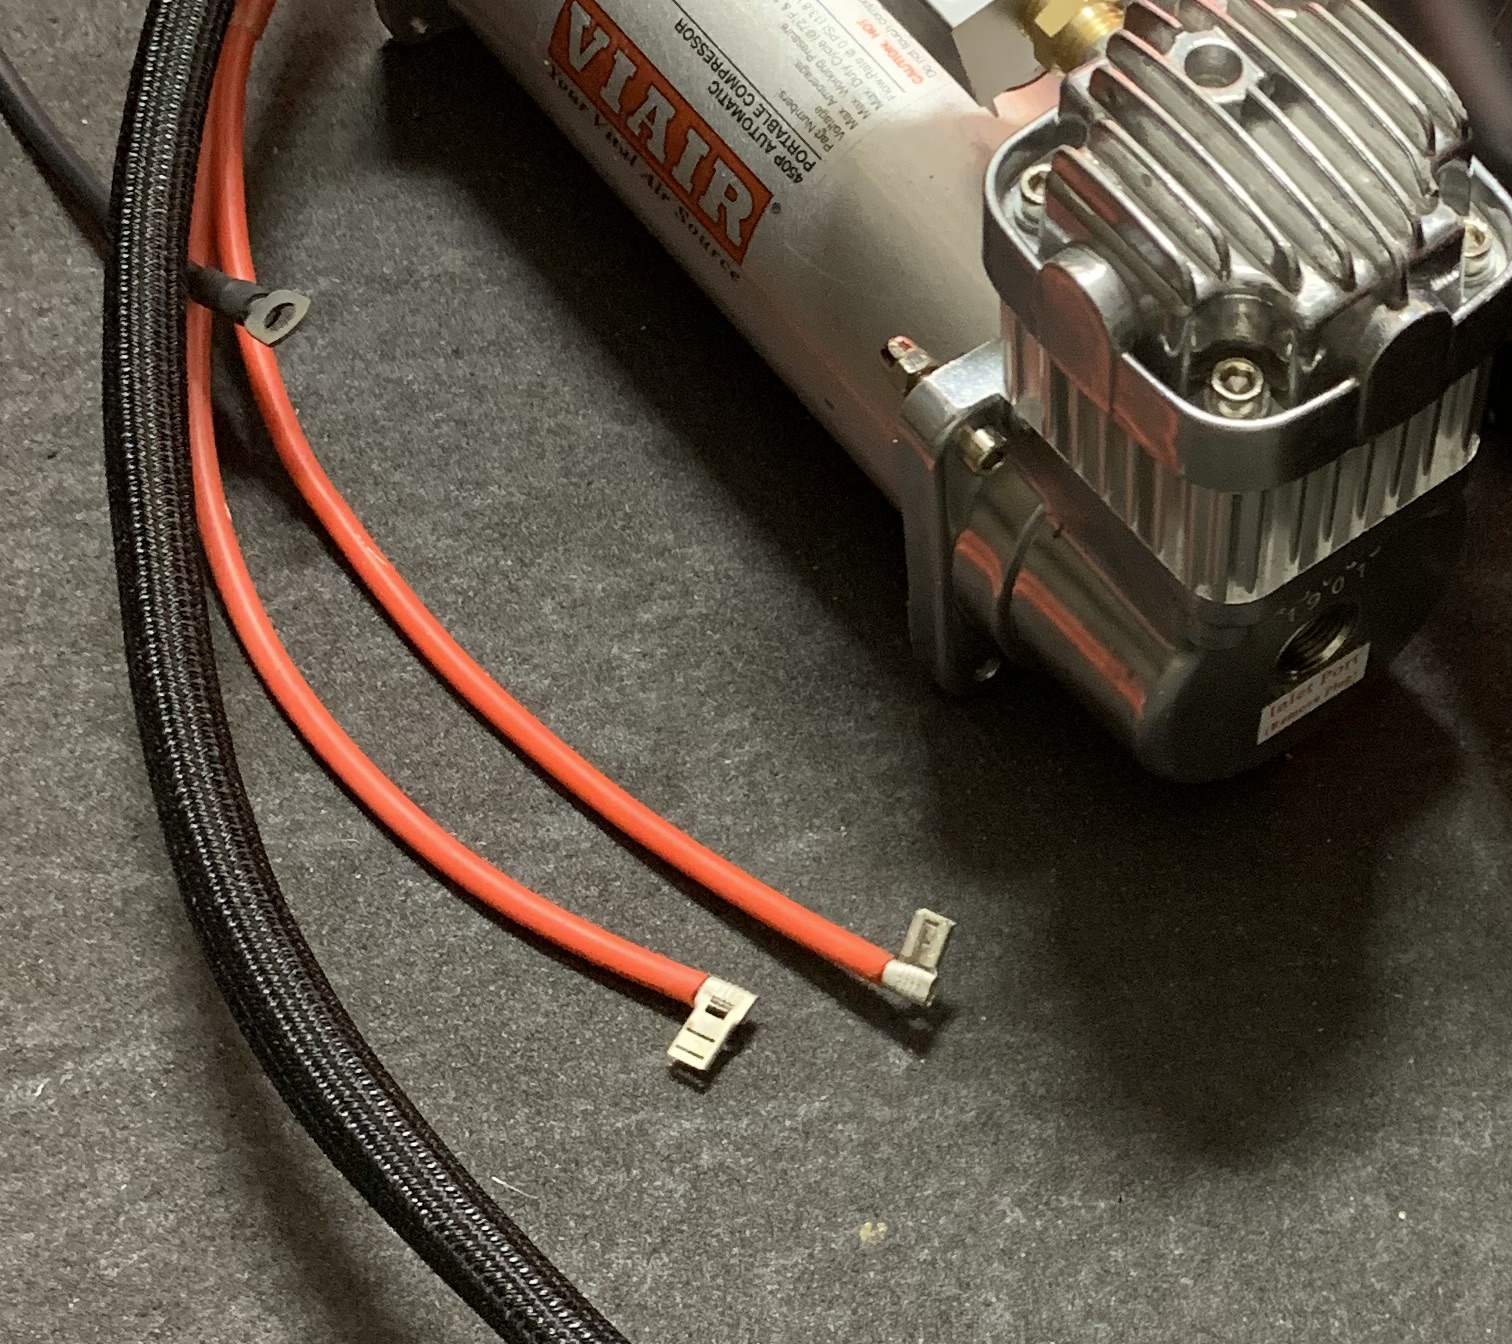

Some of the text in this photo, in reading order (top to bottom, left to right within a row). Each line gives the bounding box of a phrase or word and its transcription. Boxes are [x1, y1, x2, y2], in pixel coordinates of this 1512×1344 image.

[568, 2, 754, 244] VIAIR
[672, 17, 816, 172] PORTABLE COMPRESSOR
[814, 57, 849, 97] Working
[705, 79, 805, 185] 450P AUTOMATIC
[812, 129, 834, 152] Part
